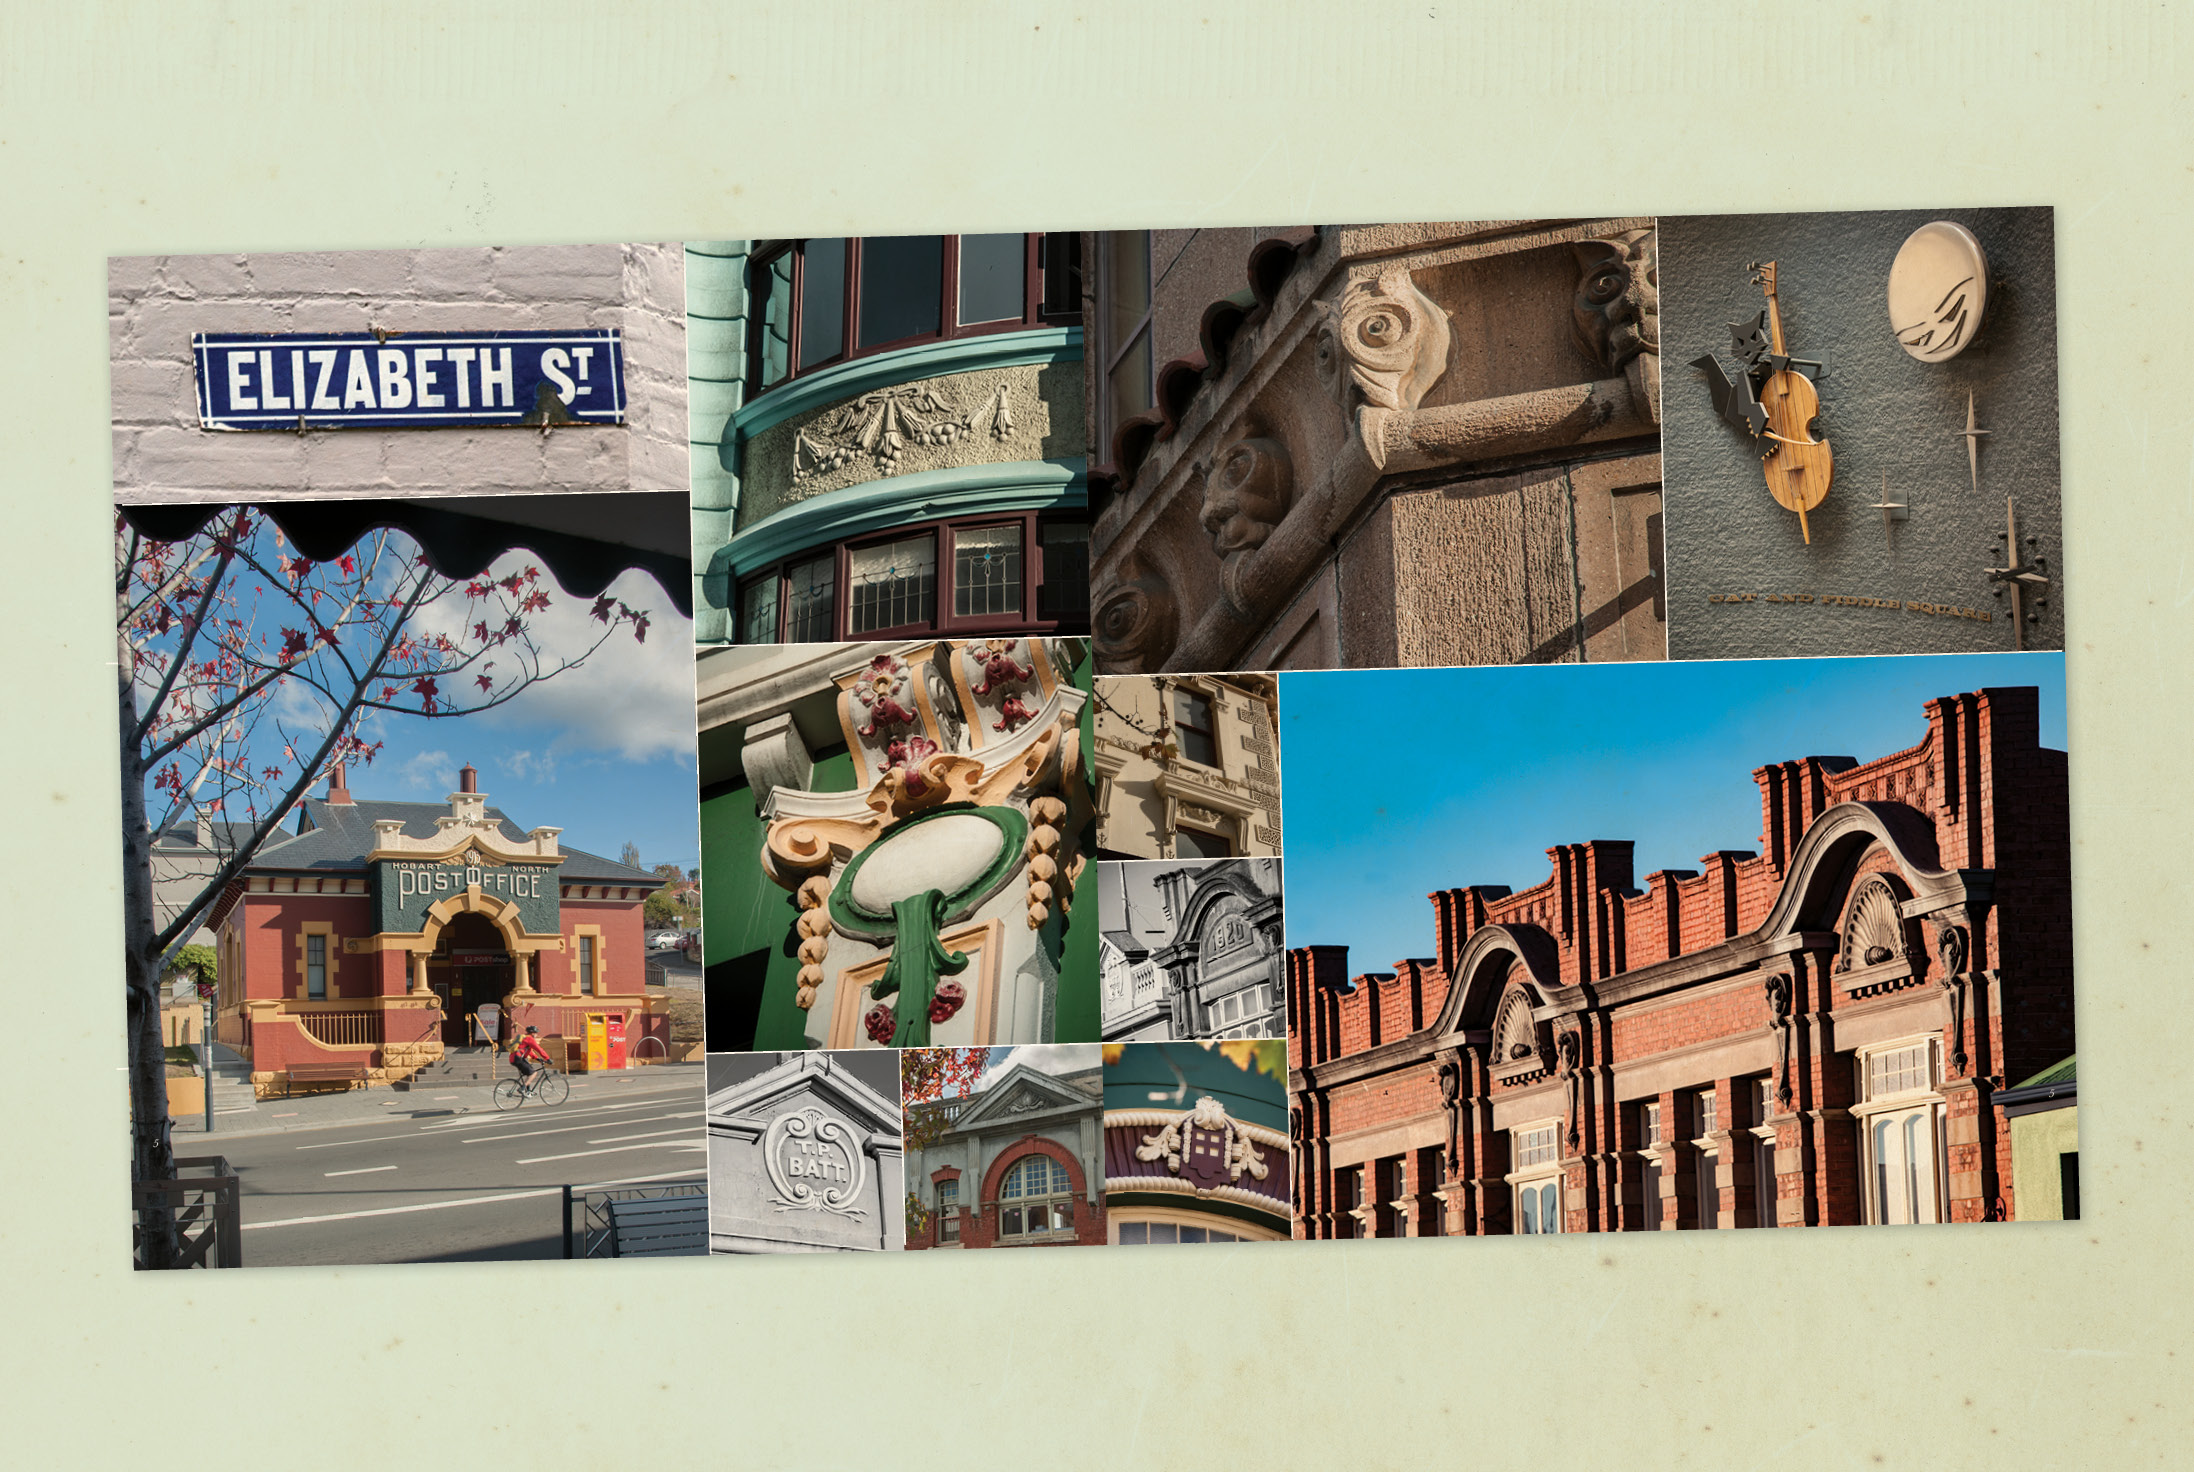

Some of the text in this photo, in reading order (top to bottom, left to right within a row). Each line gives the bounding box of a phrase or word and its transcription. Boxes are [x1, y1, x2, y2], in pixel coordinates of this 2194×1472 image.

[227, 346, 513, 411] ELIZABETH
[1708, 593, 1991, 622] CAT AND FIDDLE SQUARE
[392, 862, 549, 874] HOBART NORTH
[399, 865, 541, 910] POST OFFICE
[794, 1140, 834, 1159] T.P.
[788, 1157, 847, 1183] BATT.
